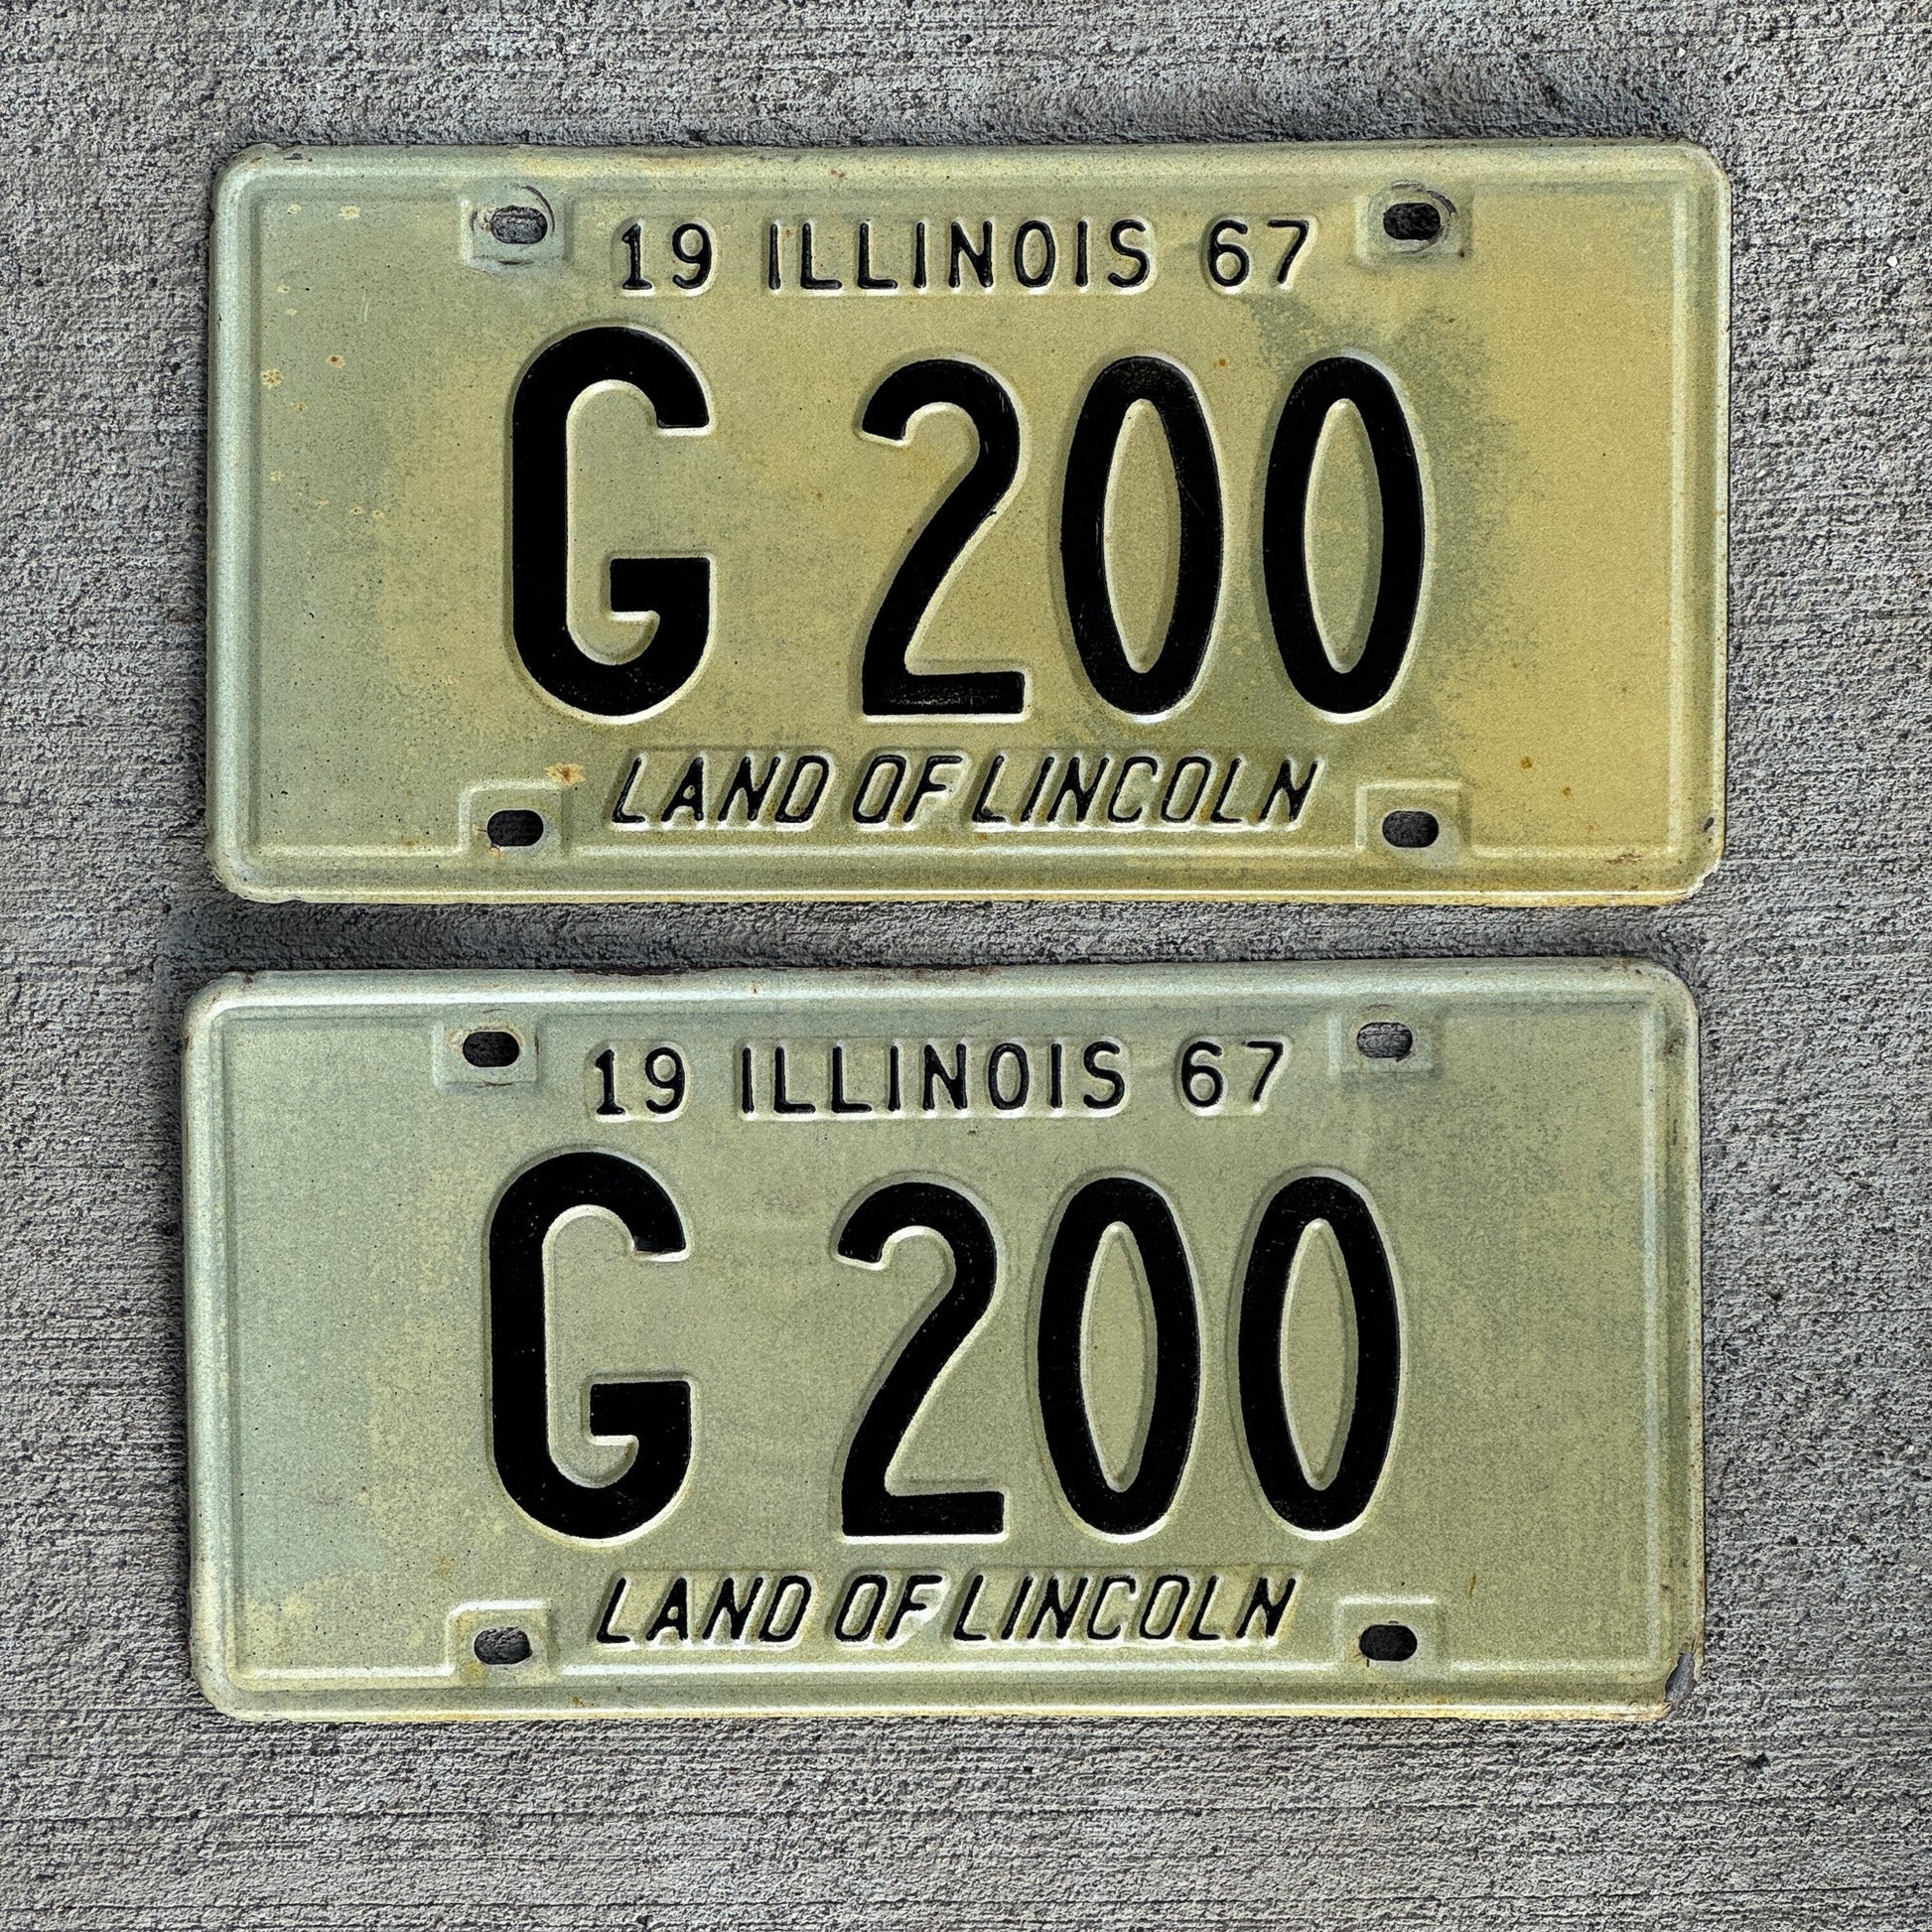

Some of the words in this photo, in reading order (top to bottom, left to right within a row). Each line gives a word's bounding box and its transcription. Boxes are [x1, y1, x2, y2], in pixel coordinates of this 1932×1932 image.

[621, 222, 713, 291] 19
[767, 219, 1148, 290] ILLINOIS
[1206, 219, 1318, 287] 67
[508, 326, 712, 717] G
[861, 355, 1426, 716] 200
[611, 756, 830, 824] LAND
[852, 754, 963, 824] OF
[971, 756, 1326, 824] LINCOLN
[594, 1046, 686, 1116] 19
[741, 1040, 1125, 1114] ILLINOIS
[1180, 1039, 1286, 1109] 67
[488, 1151, 692, 1540] G
[837, 1175, 1401, 1538] 200
[596, 1575, 812, 1644] LAND
[834, 1574, 949, 1642] OF
[952, 1574, 1297, 1642] LINCOLN
